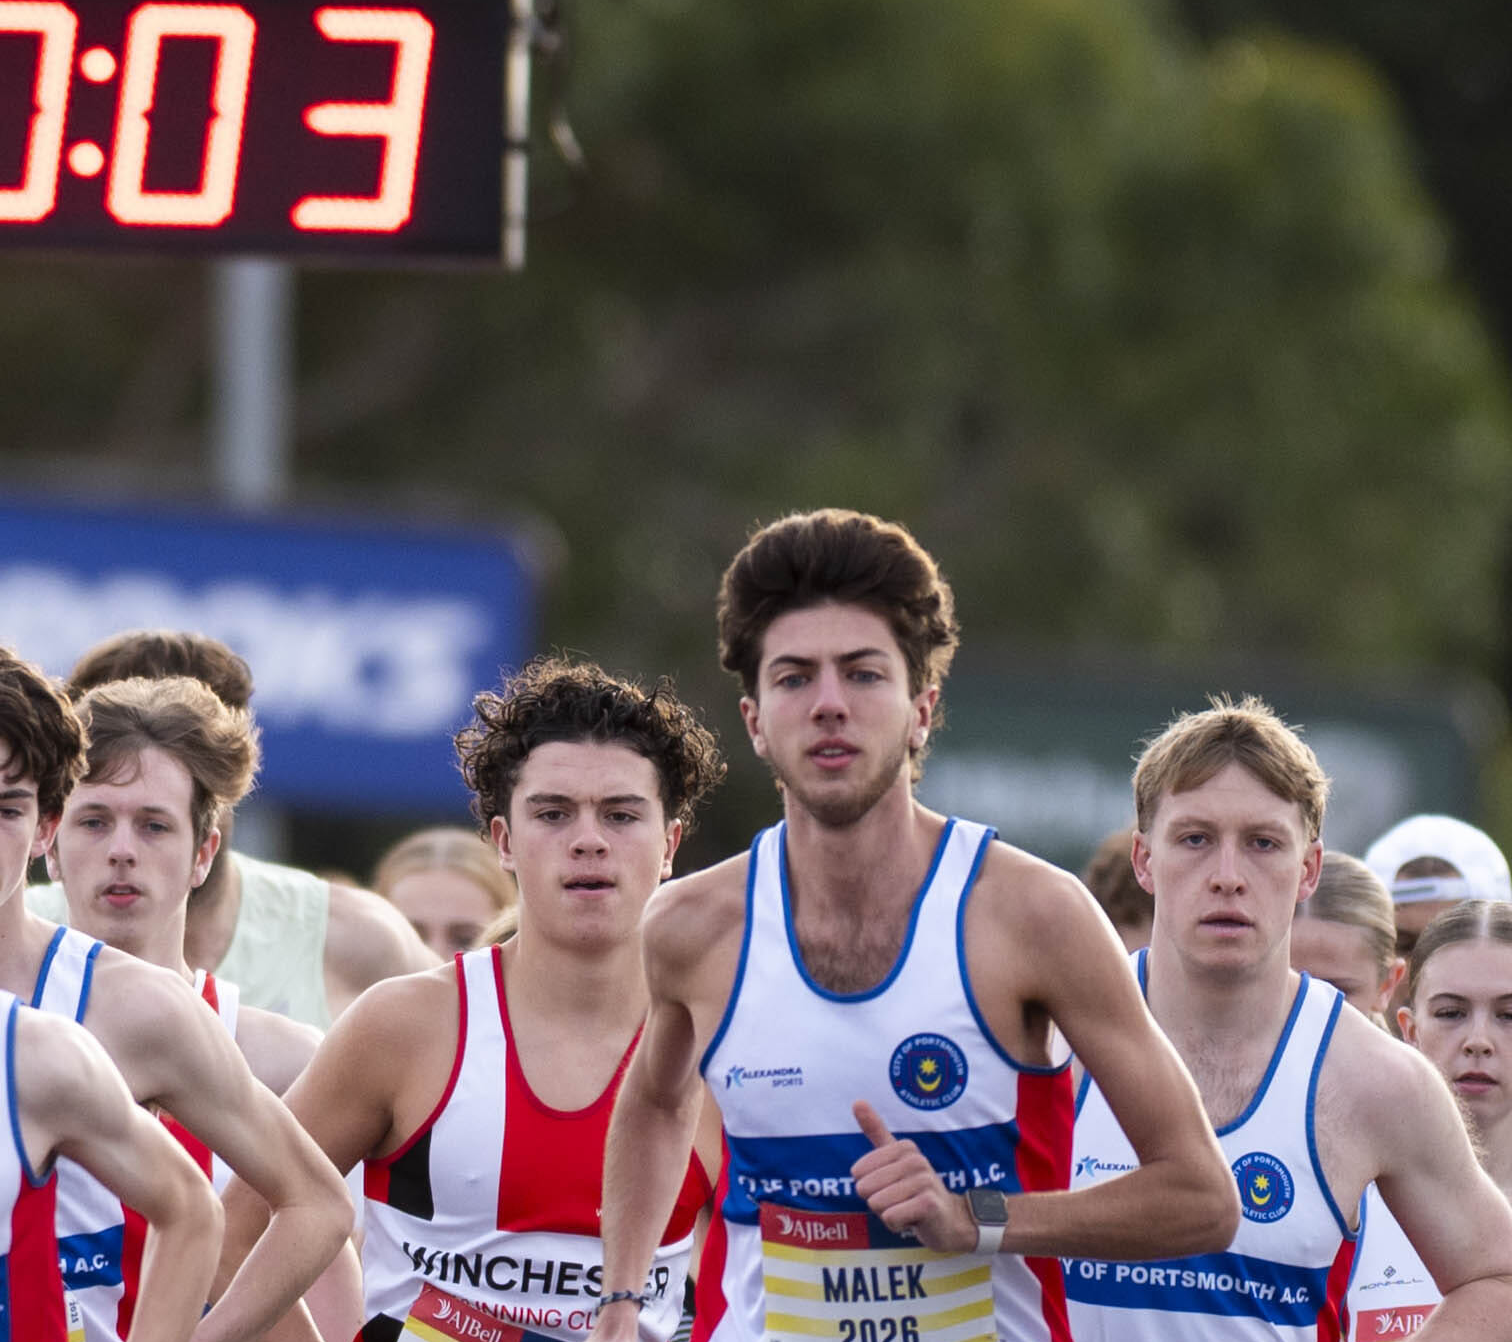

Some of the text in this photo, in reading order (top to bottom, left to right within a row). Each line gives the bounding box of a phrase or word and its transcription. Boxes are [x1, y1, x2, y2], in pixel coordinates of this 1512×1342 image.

[915, 1037, 965, 1077] PORTSMOUTH
[742, 1067, 803, 1079] ALEXANDRA
[772, 1078, 804, 1088] SPORTS
[1253, 1155, 1292, 1199] PORTSMOUTH
[1268, 1205, 1287, 1219] CLUB
[792, 1220, 848, 1243] AJBell
[74, 1253, 110, 1274] A.C.
[822, 1263, 928, 1303] MALEK
[1080, 1261, 1108, 1280] OF
[1115, 1264, 1276, 1301] PORTSMOUTH
[1280, 1287, 1310, 1305] A.C.
